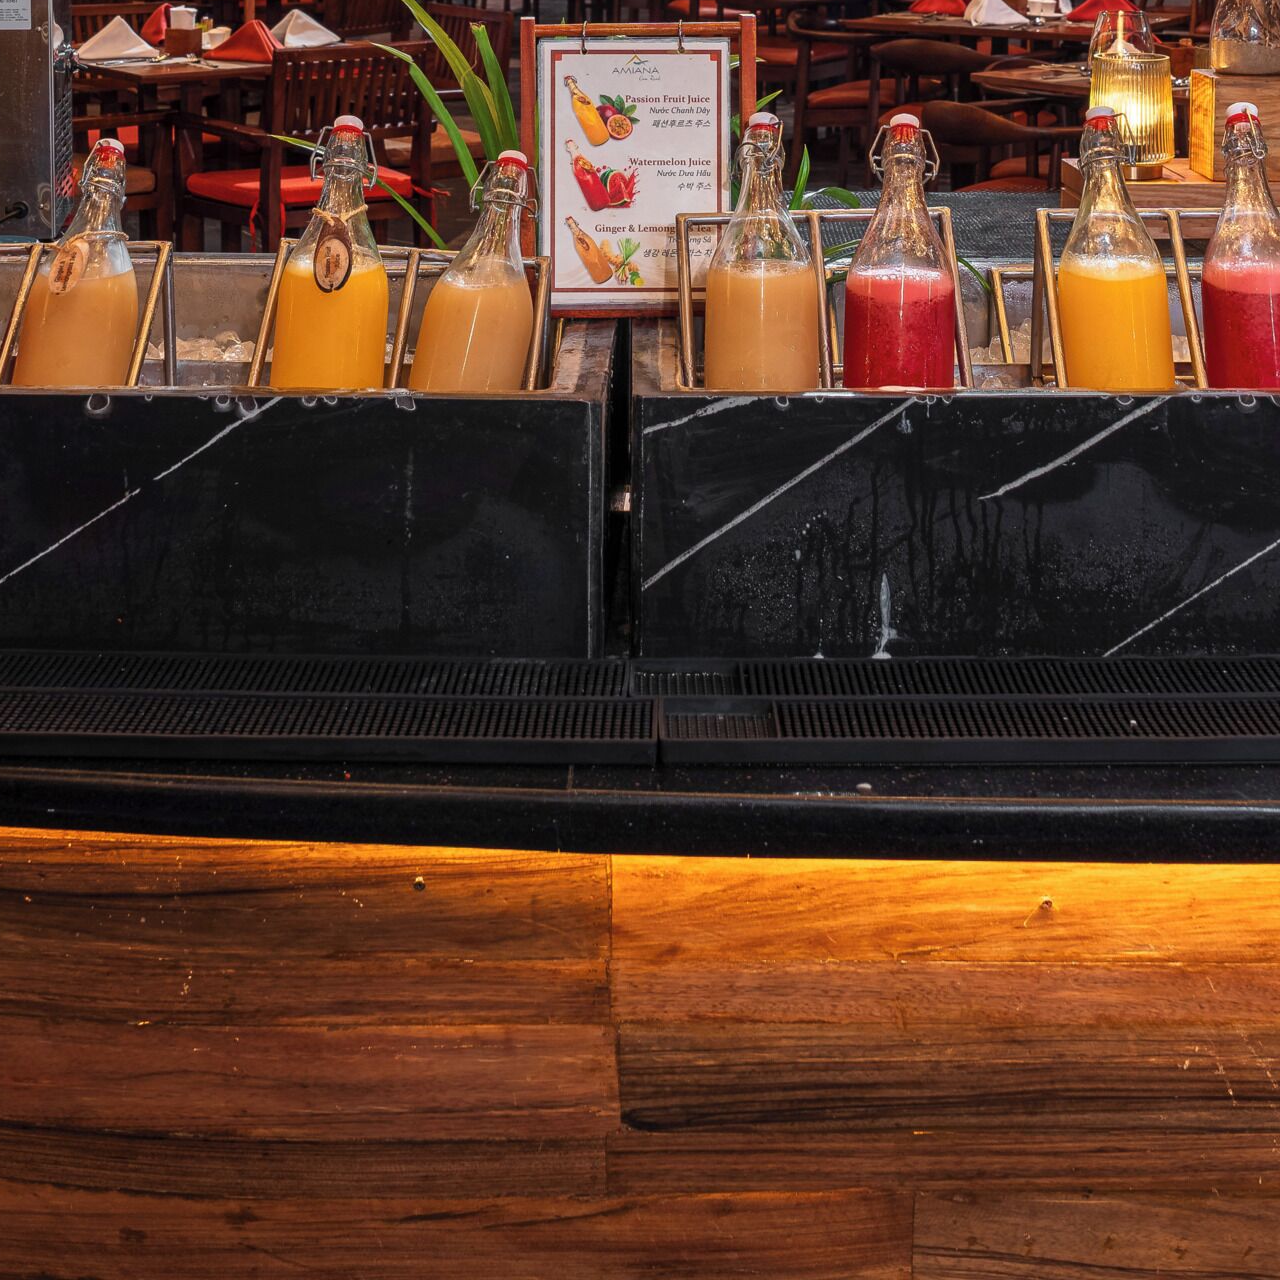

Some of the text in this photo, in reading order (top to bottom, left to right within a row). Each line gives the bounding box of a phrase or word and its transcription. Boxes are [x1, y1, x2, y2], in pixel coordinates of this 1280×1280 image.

[625, 94, 711, 105] Passion Fruit Juice
[671, 106, 694, 114] Chanh
[629, 157, 711, 167] Watermelon Juice
[595, 224, 626, 235] Ginger
[628, 225, 635, 233] &
[638, 224, 694, 235] Lemongs
